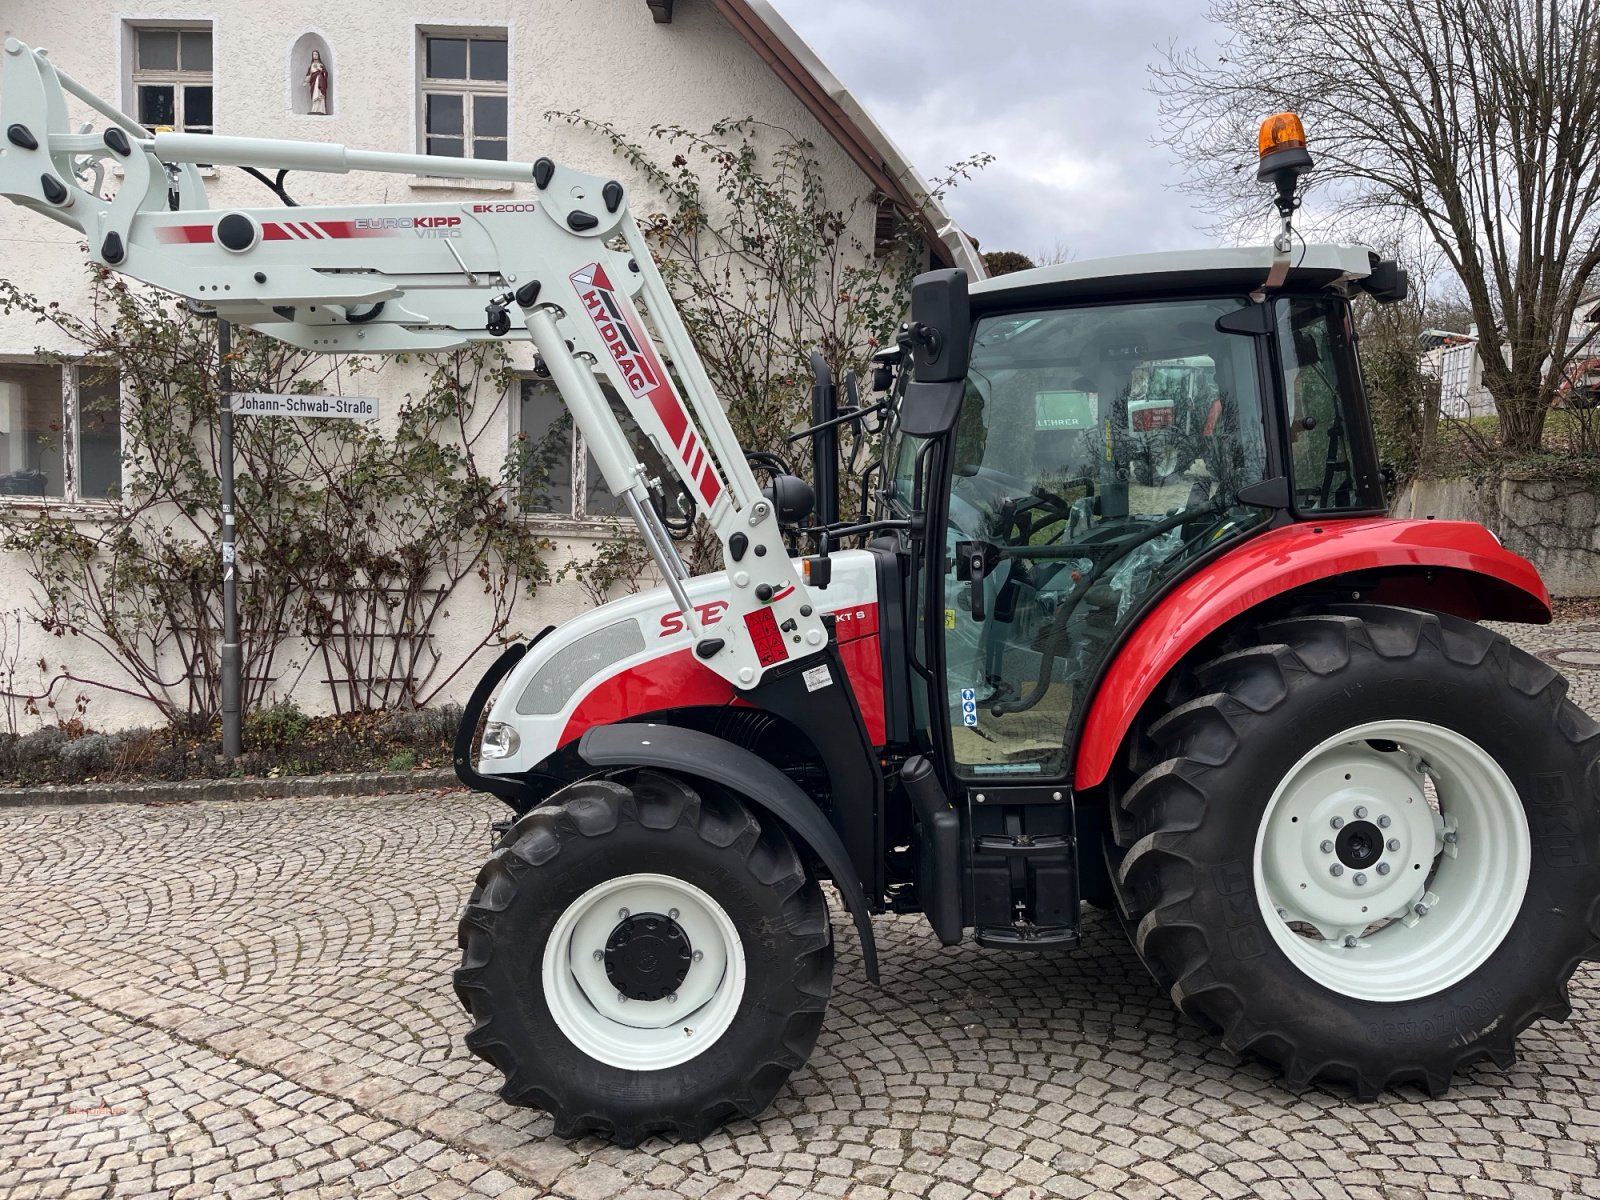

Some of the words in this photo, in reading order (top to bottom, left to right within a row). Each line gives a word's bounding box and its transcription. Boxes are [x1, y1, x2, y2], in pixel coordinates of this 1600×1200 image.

[473, 204, 493, 213] EK
[495, 204, 535, 213] 2000
[354, 216, 462, 229] EUROKIPP
[582, 290, 645, 391] HYDRAC
[239, 397, 373, 414] Johann-Schwab-Straße
[835, 612, 852, 622] KT
[856, 610, 865, 619] S
